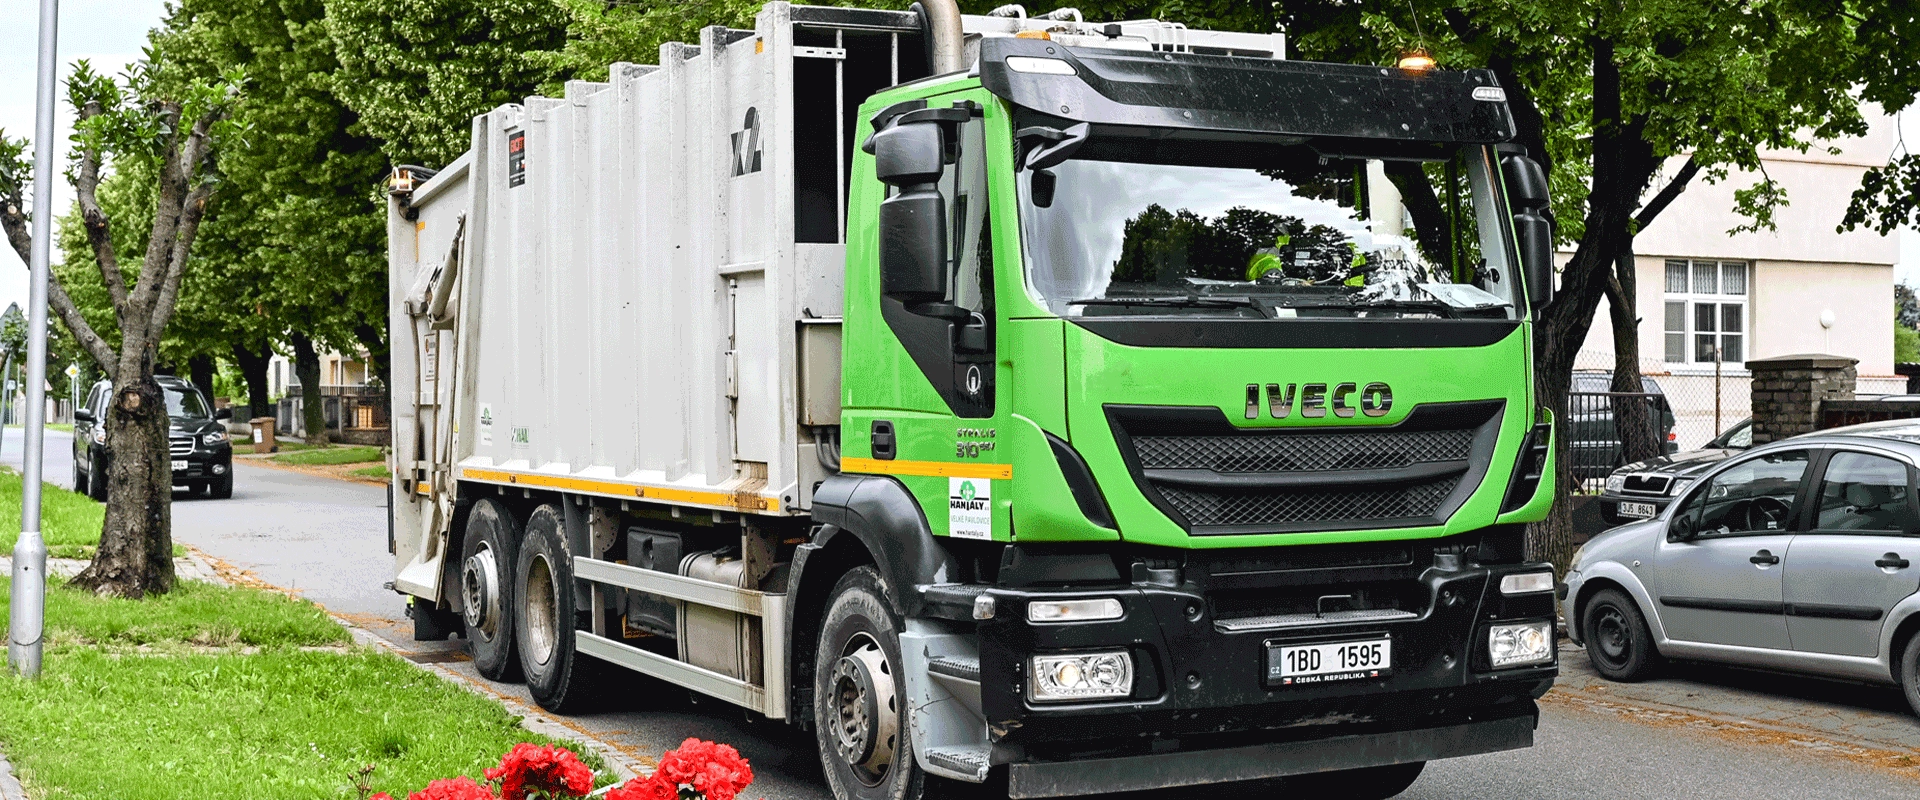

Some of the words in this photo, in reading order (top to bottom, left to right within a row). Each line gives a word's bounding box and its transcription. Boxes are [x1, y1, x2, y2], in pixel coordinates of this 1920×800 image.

[1245, 382, 1393, 419] IVECO
[957, 428, 996, 438] STRALIS
[956, 441, 980, 459] 310
[1622, 503, 1634, 513] 3J5
[1287, 648, 1321, 673] 1BD
[1337, 643, 1382, 669] 1595
[1270, 666, 1280, 674] CZ
[1324, 672, 1365, 681] REPUBLIKA
